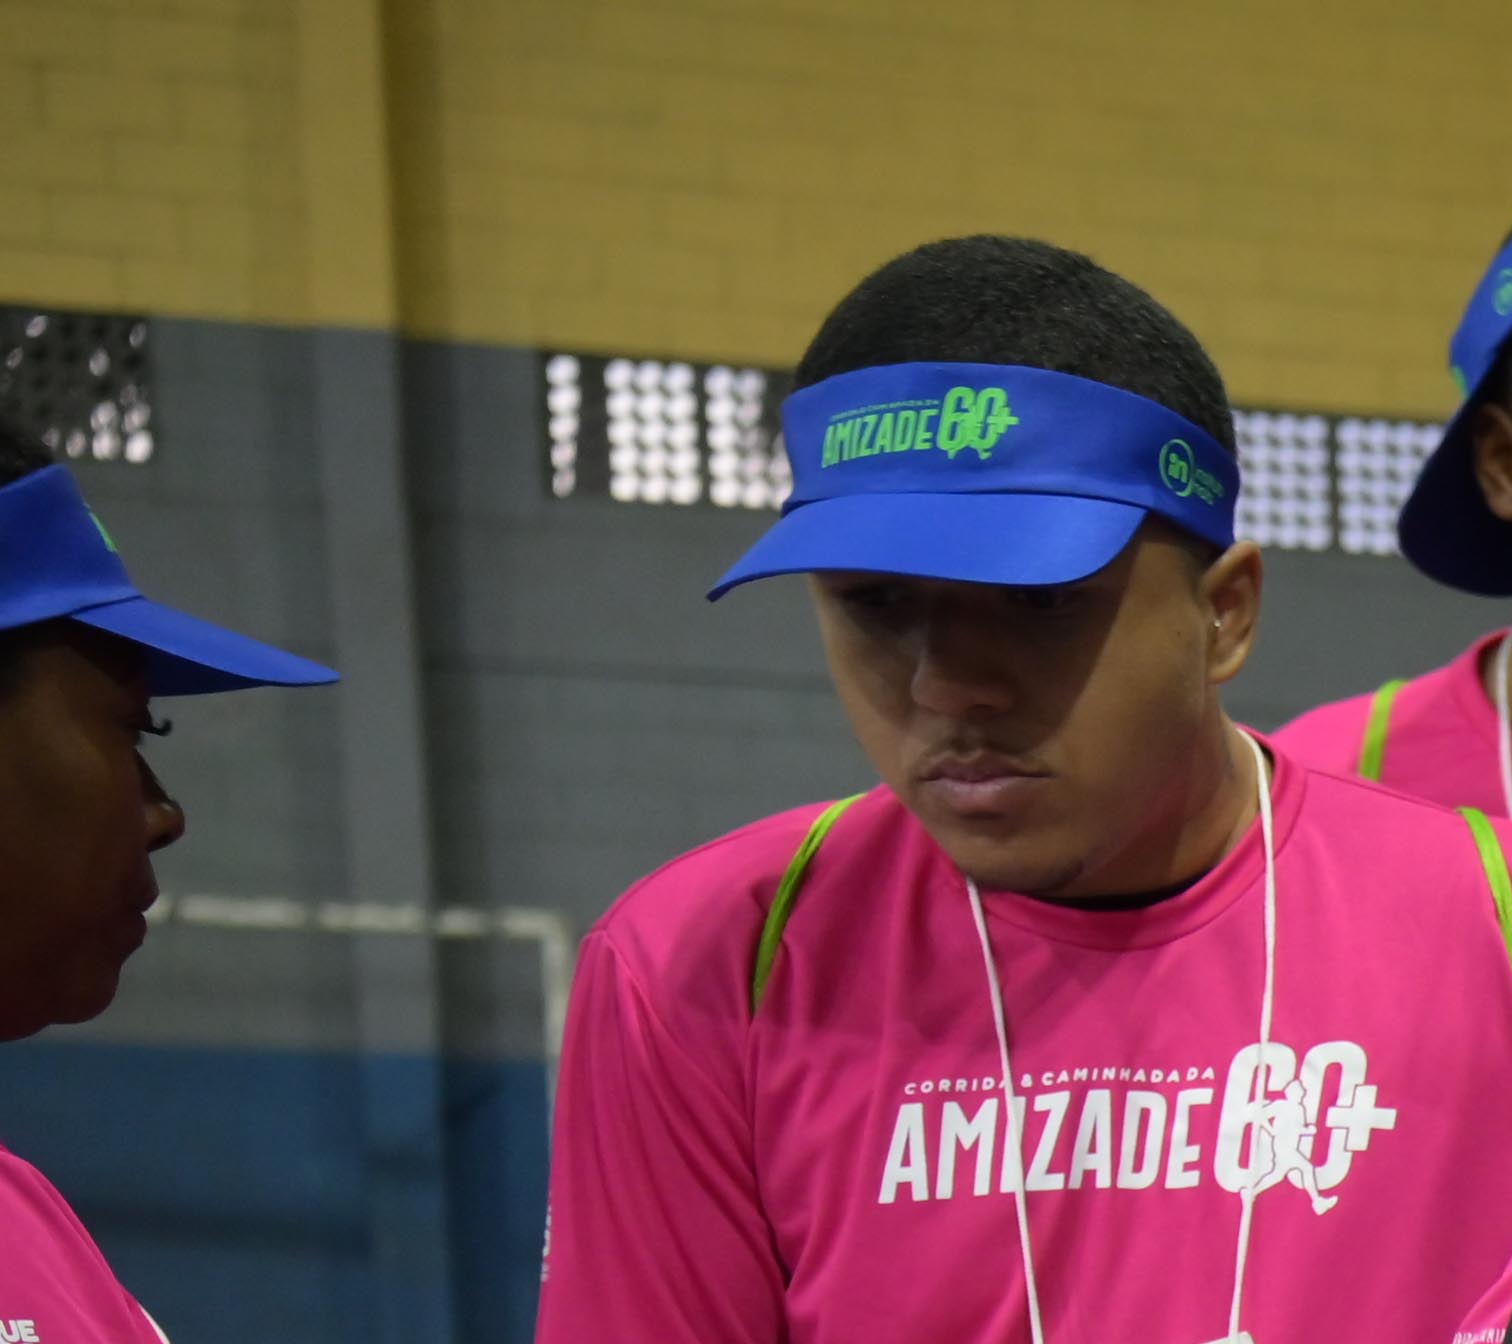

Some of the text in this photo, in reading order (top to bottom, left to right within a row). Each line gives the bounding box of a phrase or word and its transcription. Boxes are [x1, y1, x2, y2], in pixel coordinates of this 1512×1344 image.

[821, 386, 1020, 468] AMIZADE 60+
[1020, 1068, 1034, 1088] &
[1042, 1066, 1179, 1087] CAMINHADA
[1186, 1066, 1216, 1082] DA
[878, 1041, 1397, 1205] AMIZADE 60+
